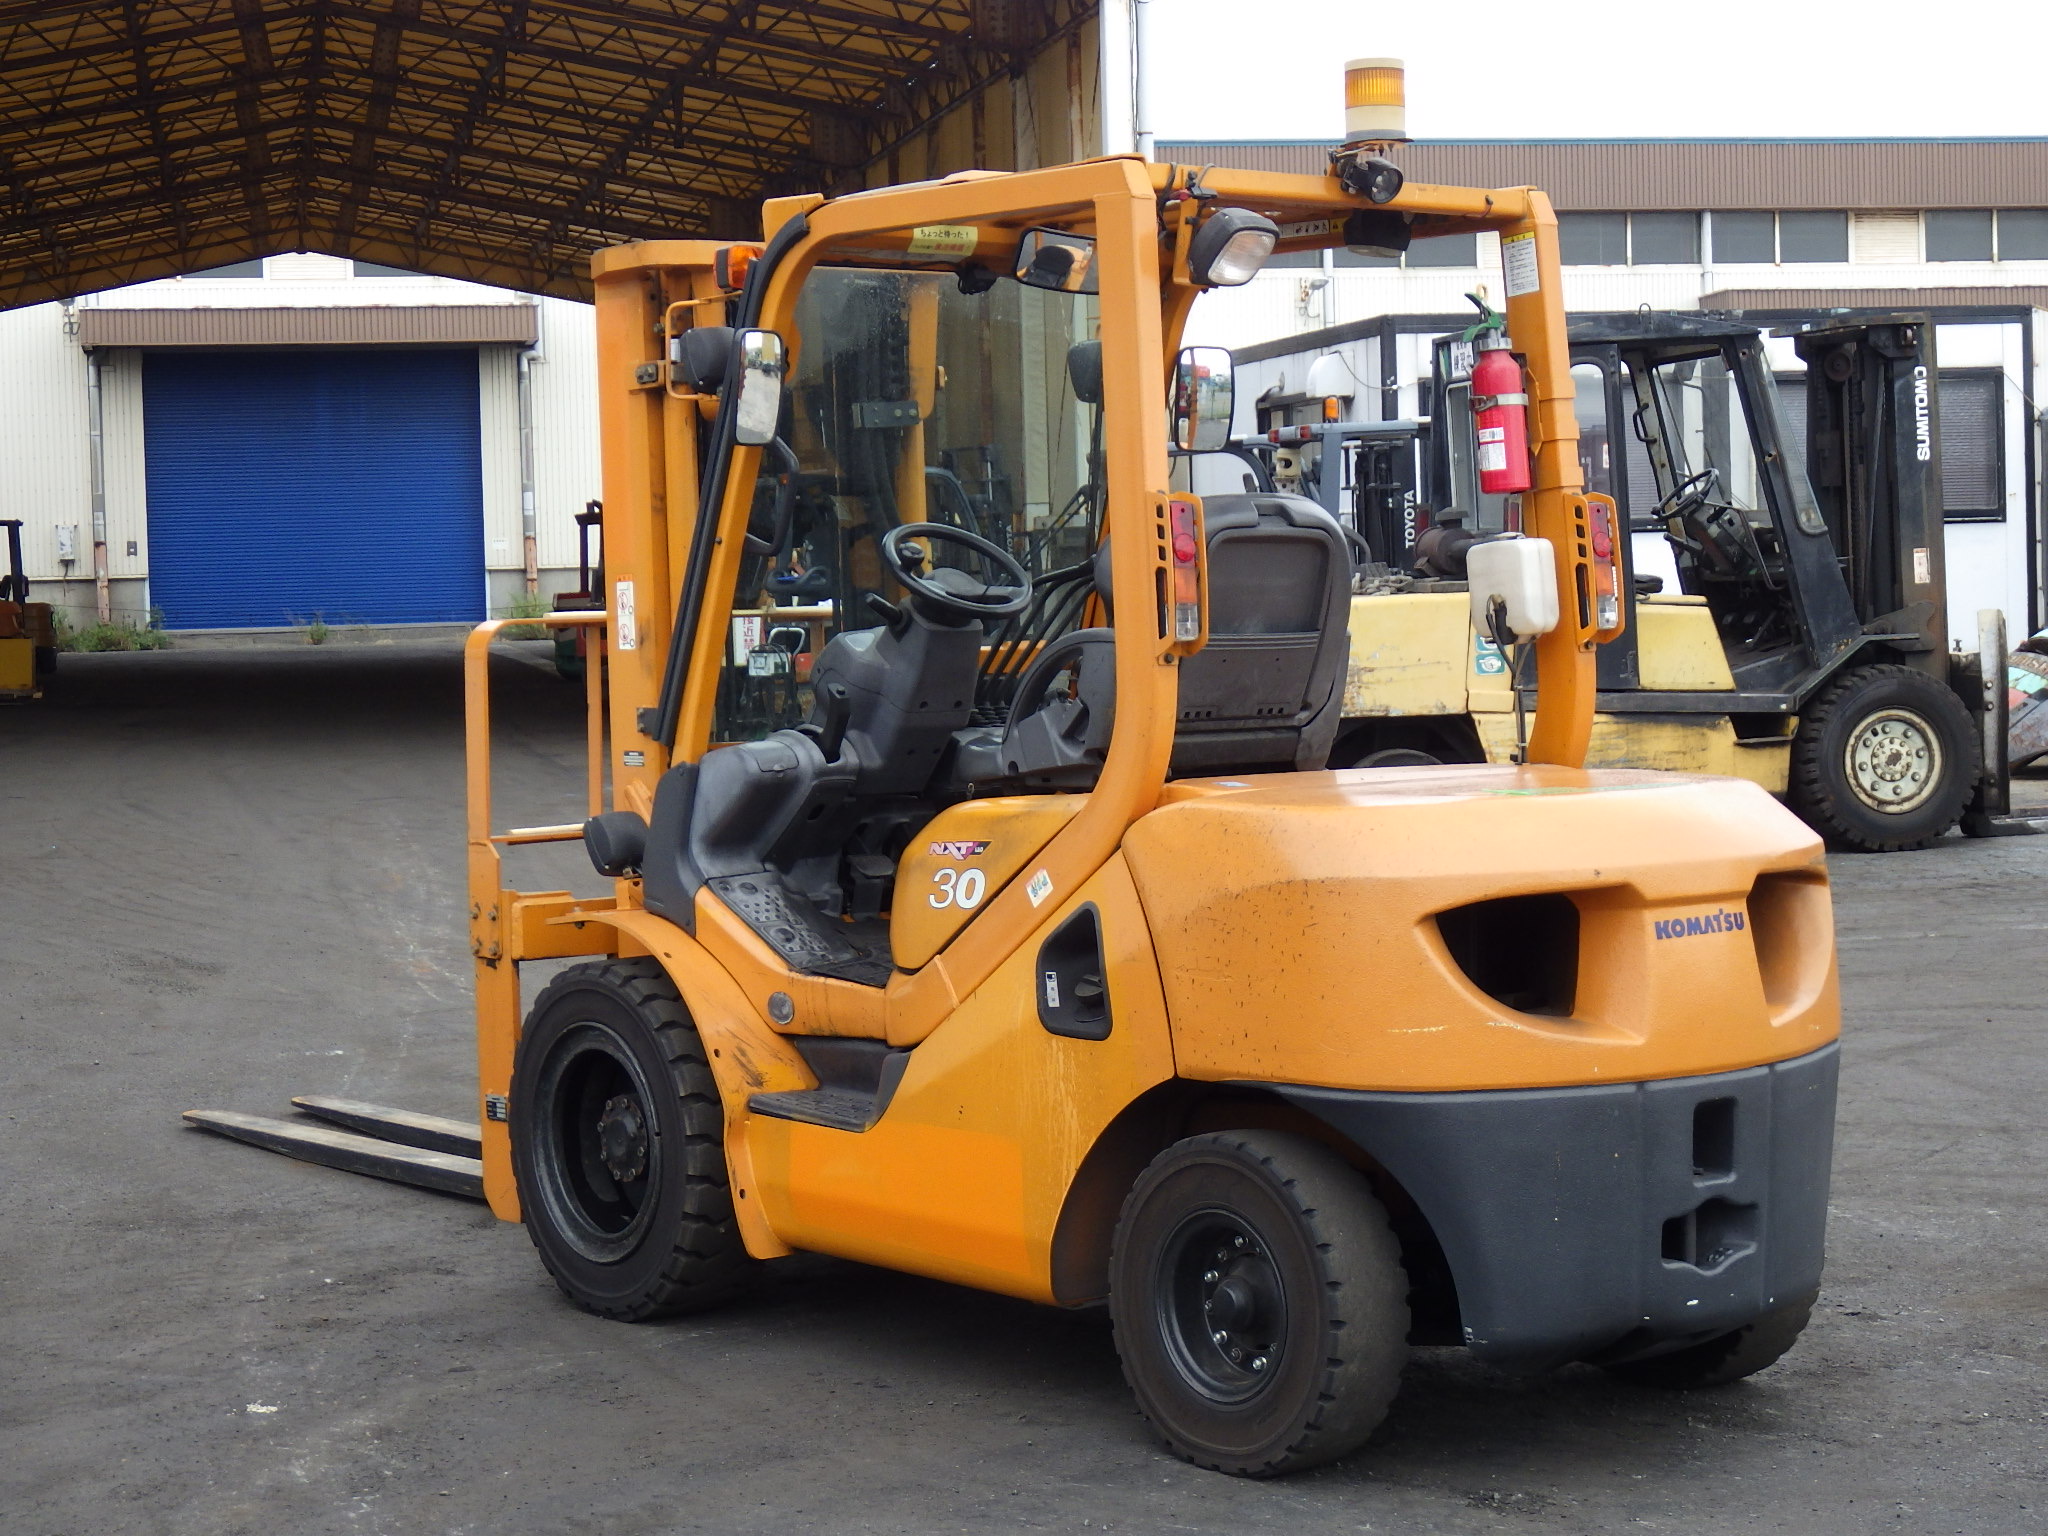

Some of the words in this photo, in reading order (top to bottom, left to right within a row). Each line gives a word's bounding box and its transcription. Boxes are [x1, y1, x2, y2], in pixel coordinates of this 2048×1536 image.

[1914, 366, 1931, 461] SUMITOMO
[1404, 489, 1416, 549] TOYOTA
[928, 841, 974, 861] NXT
[929, 868, 987, 909] 30
[1654, 908, 1745, 941] KOMATSU
